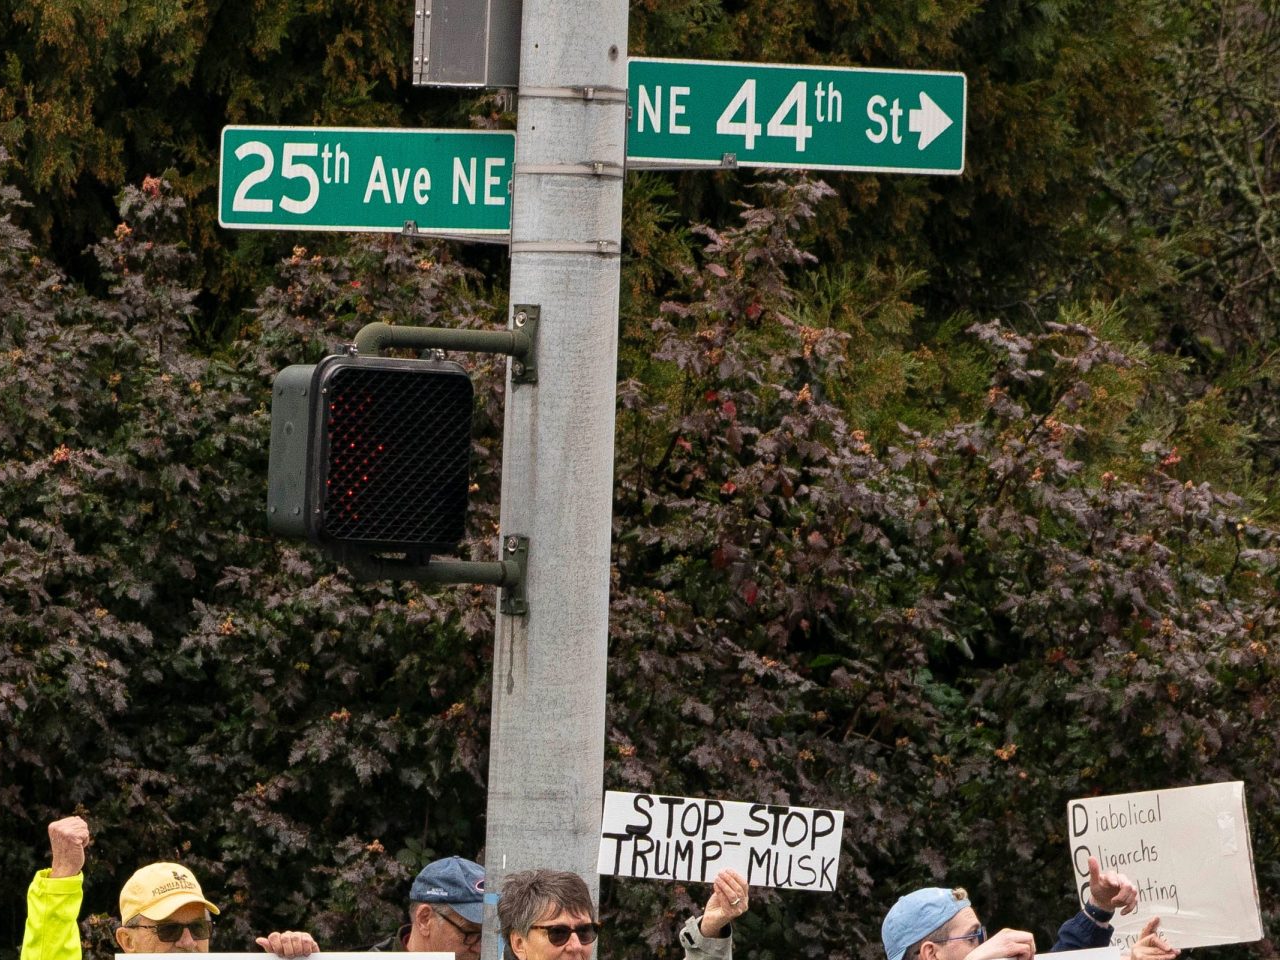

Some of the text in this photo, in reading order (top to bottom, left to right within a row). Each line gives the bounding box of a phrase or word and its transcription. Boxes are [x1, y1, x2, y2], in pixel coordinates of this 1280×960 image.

[637, 78, 903, 152] NE 44th St
[232, 140, 506, 214] 25th Ave NE
[625, 794, 724, 840] STOP
[744, 804, 835, 851] STOP
[1072, 794, 1162, 837] Diabolical
[602, 833, 836, 891] TRUMP MUSK
